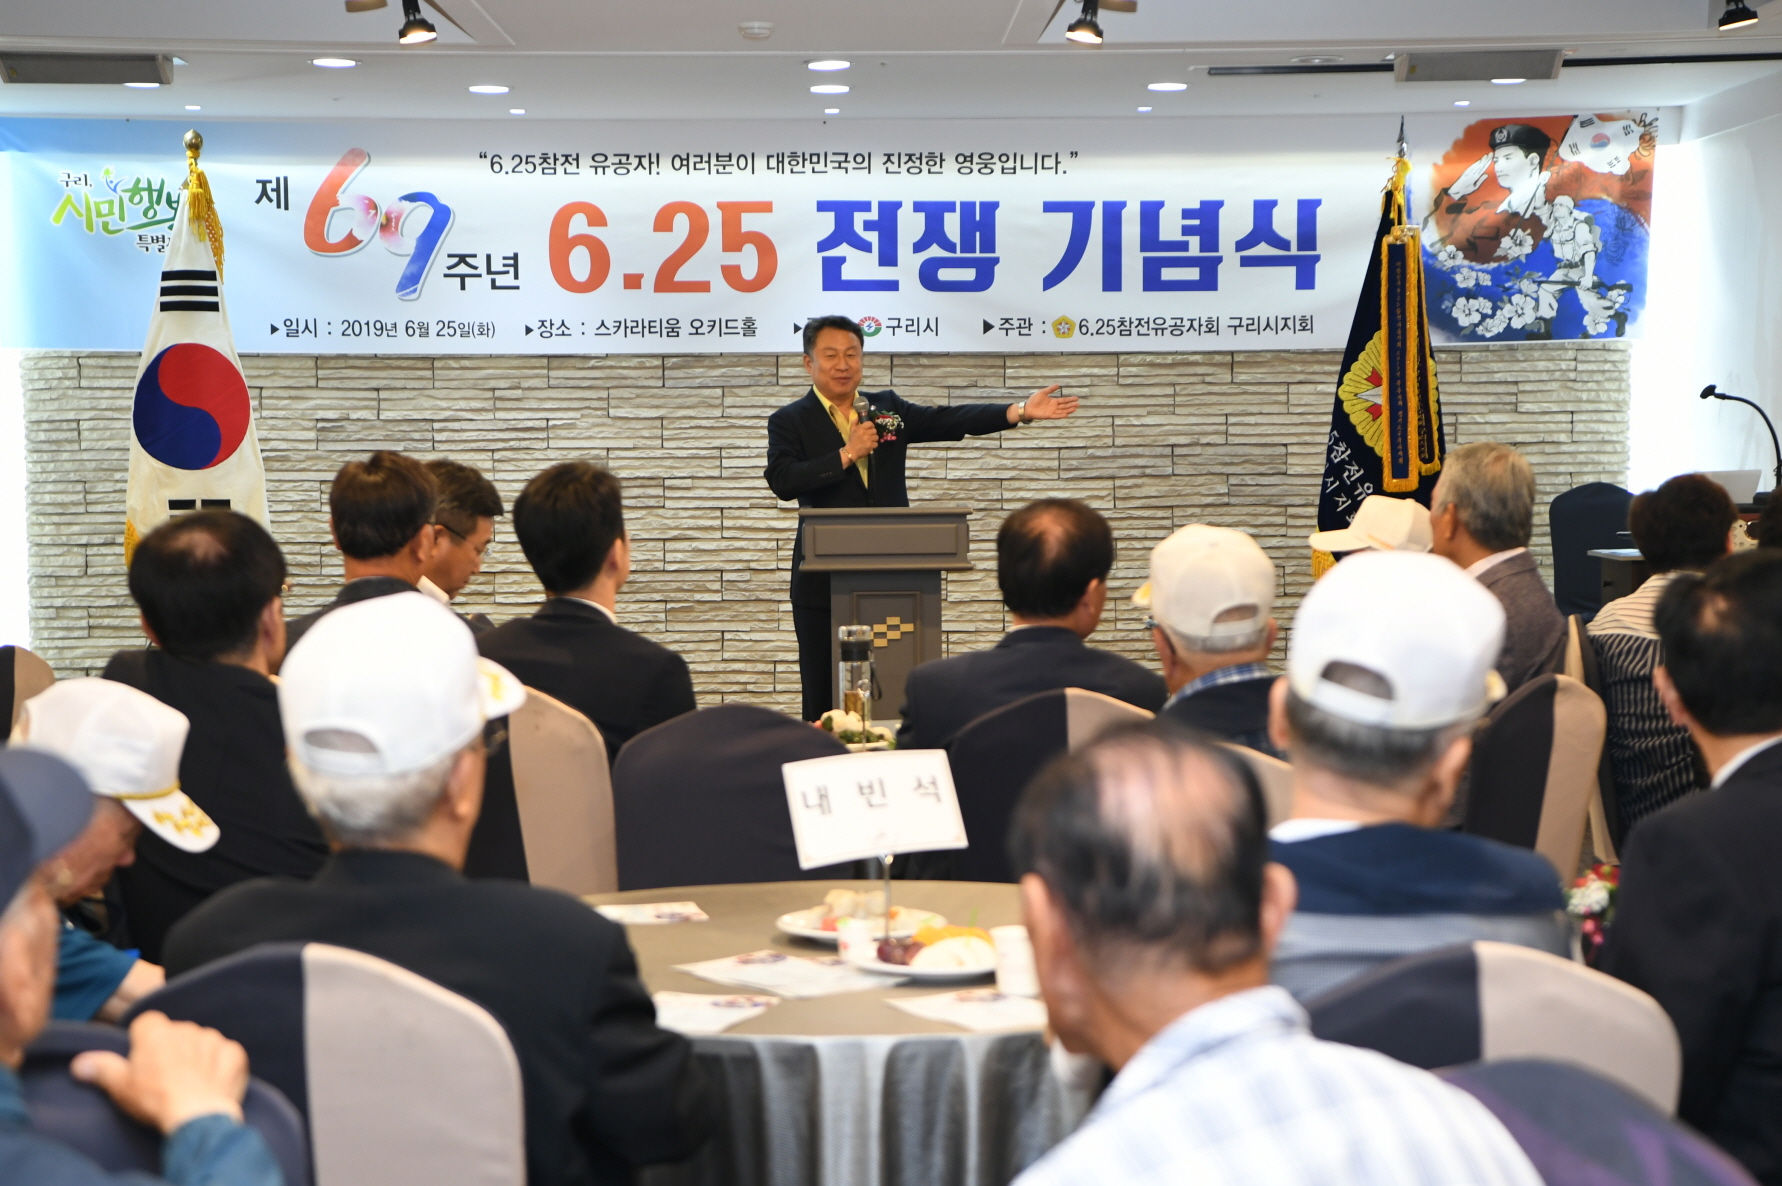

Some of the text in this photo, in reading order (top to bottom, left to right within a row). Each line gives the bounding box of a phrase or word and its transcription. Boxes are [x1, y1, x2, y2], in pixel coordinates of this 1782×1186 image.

[589, 152, 660, 175] 유공자!
[671, 152, 755, 175] 여러분이
[766, 151, 872, 174] 대한민국의
[882, 152, 946, 175] 진정한
[136, 234, 171, 253] 특별
[254, 176, 290, 211] 제
[549, 201, 778, 294] 6.25
[816, 200, 1001, 293] 전쟁
[1042, 198, 1323, 293] 기념식
[283, 317, 318, 338] 일시
[341, 319, 398, 338] 2019년
[405, 319, 430, 338] 6월
[436, 319, 496, 338] 25일(화)
[537, 318, 572, 339] 장소
[594, 317, 682, 338] 스카라티움
[688, 316, 758, 338] 오키드홀
[885, 316, 939, 337] 구리시
[998, 317, 1034, 337] 주관
[1078, 316, 1220, 337] 6.25참전유공자회
[1227, 314, 1314, 336] 구리시지회
